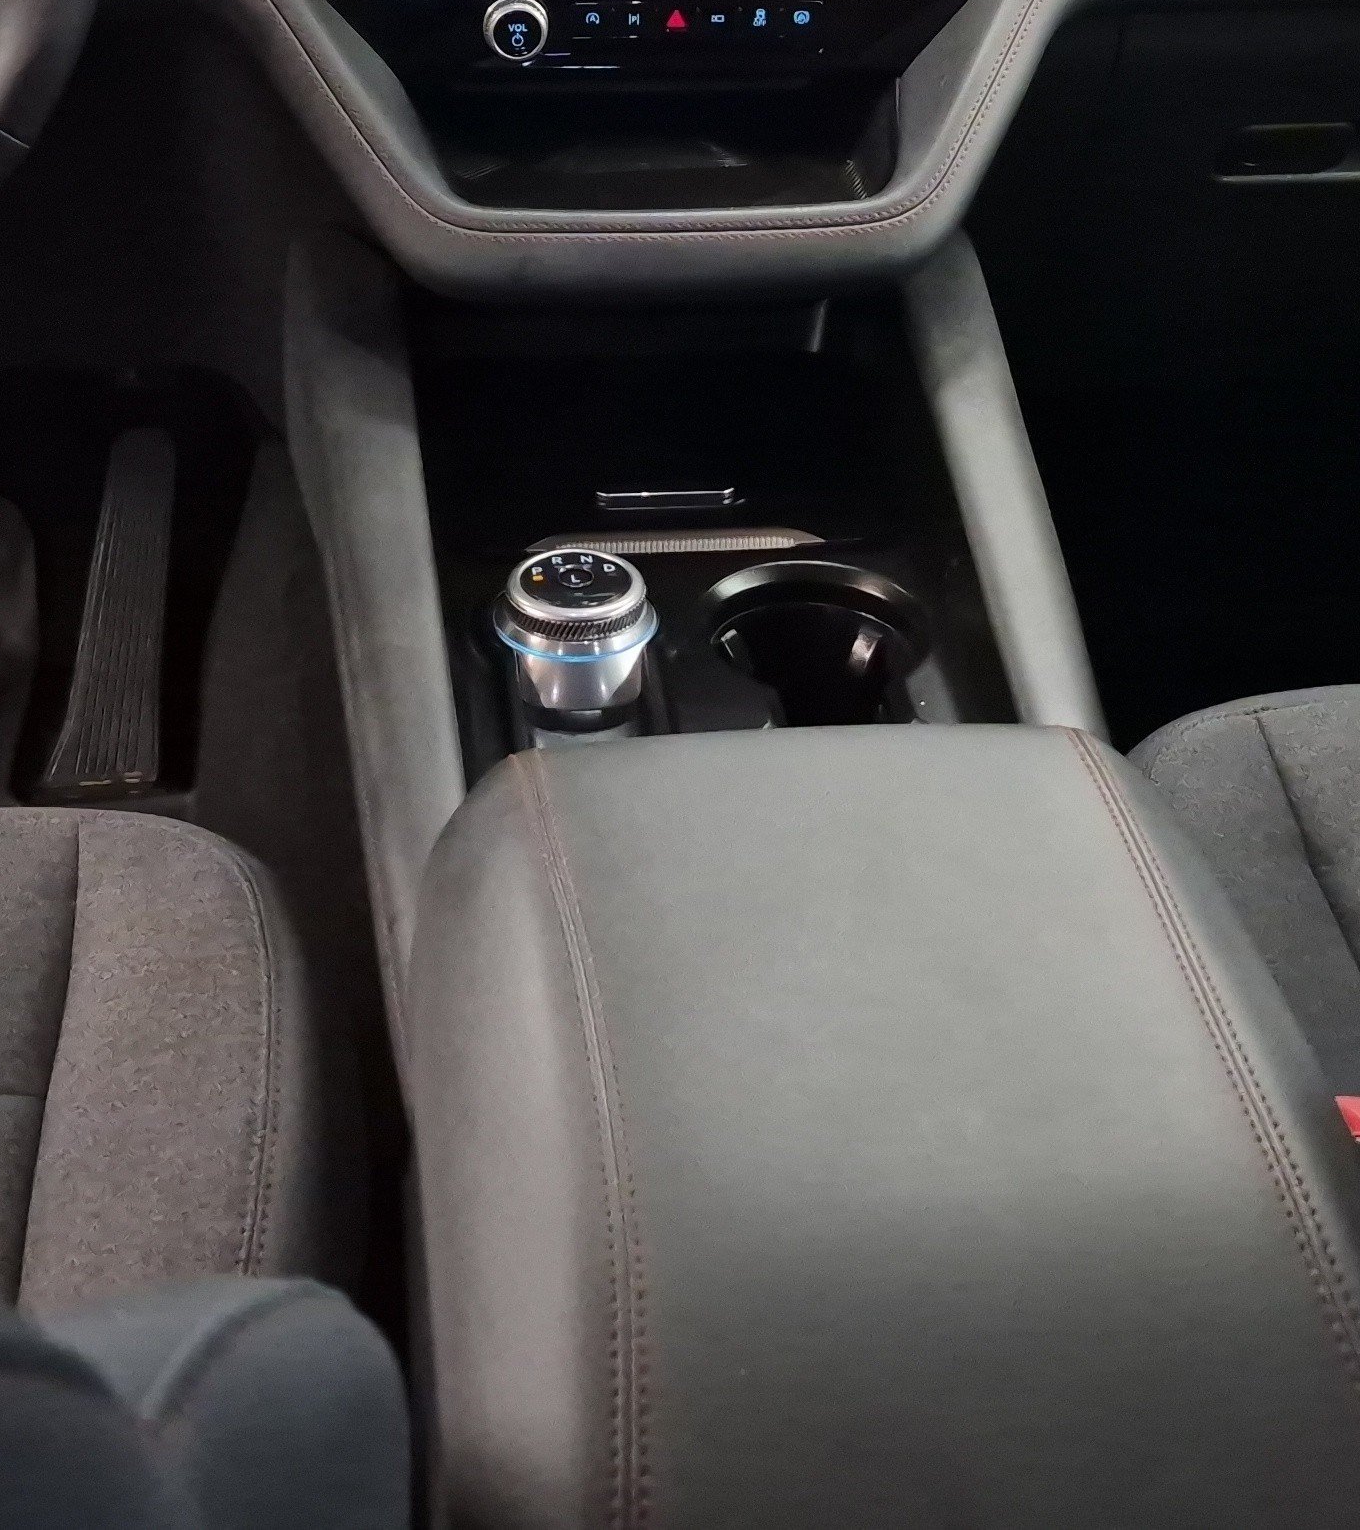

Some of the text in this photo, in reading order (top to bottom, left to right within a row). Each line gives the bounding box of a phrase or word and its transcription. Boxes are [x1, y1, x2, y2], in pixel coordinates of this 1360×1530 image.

[753, 19, 767, 27] OFF
[508, 23, 528, 33] VOL
[551, 556, 564, 564] R
[580, 555, 594, 563] N
[531, 567, 542, 575] P
[603, 563, 615, 572] D
[571, 574, 581, 583] L
